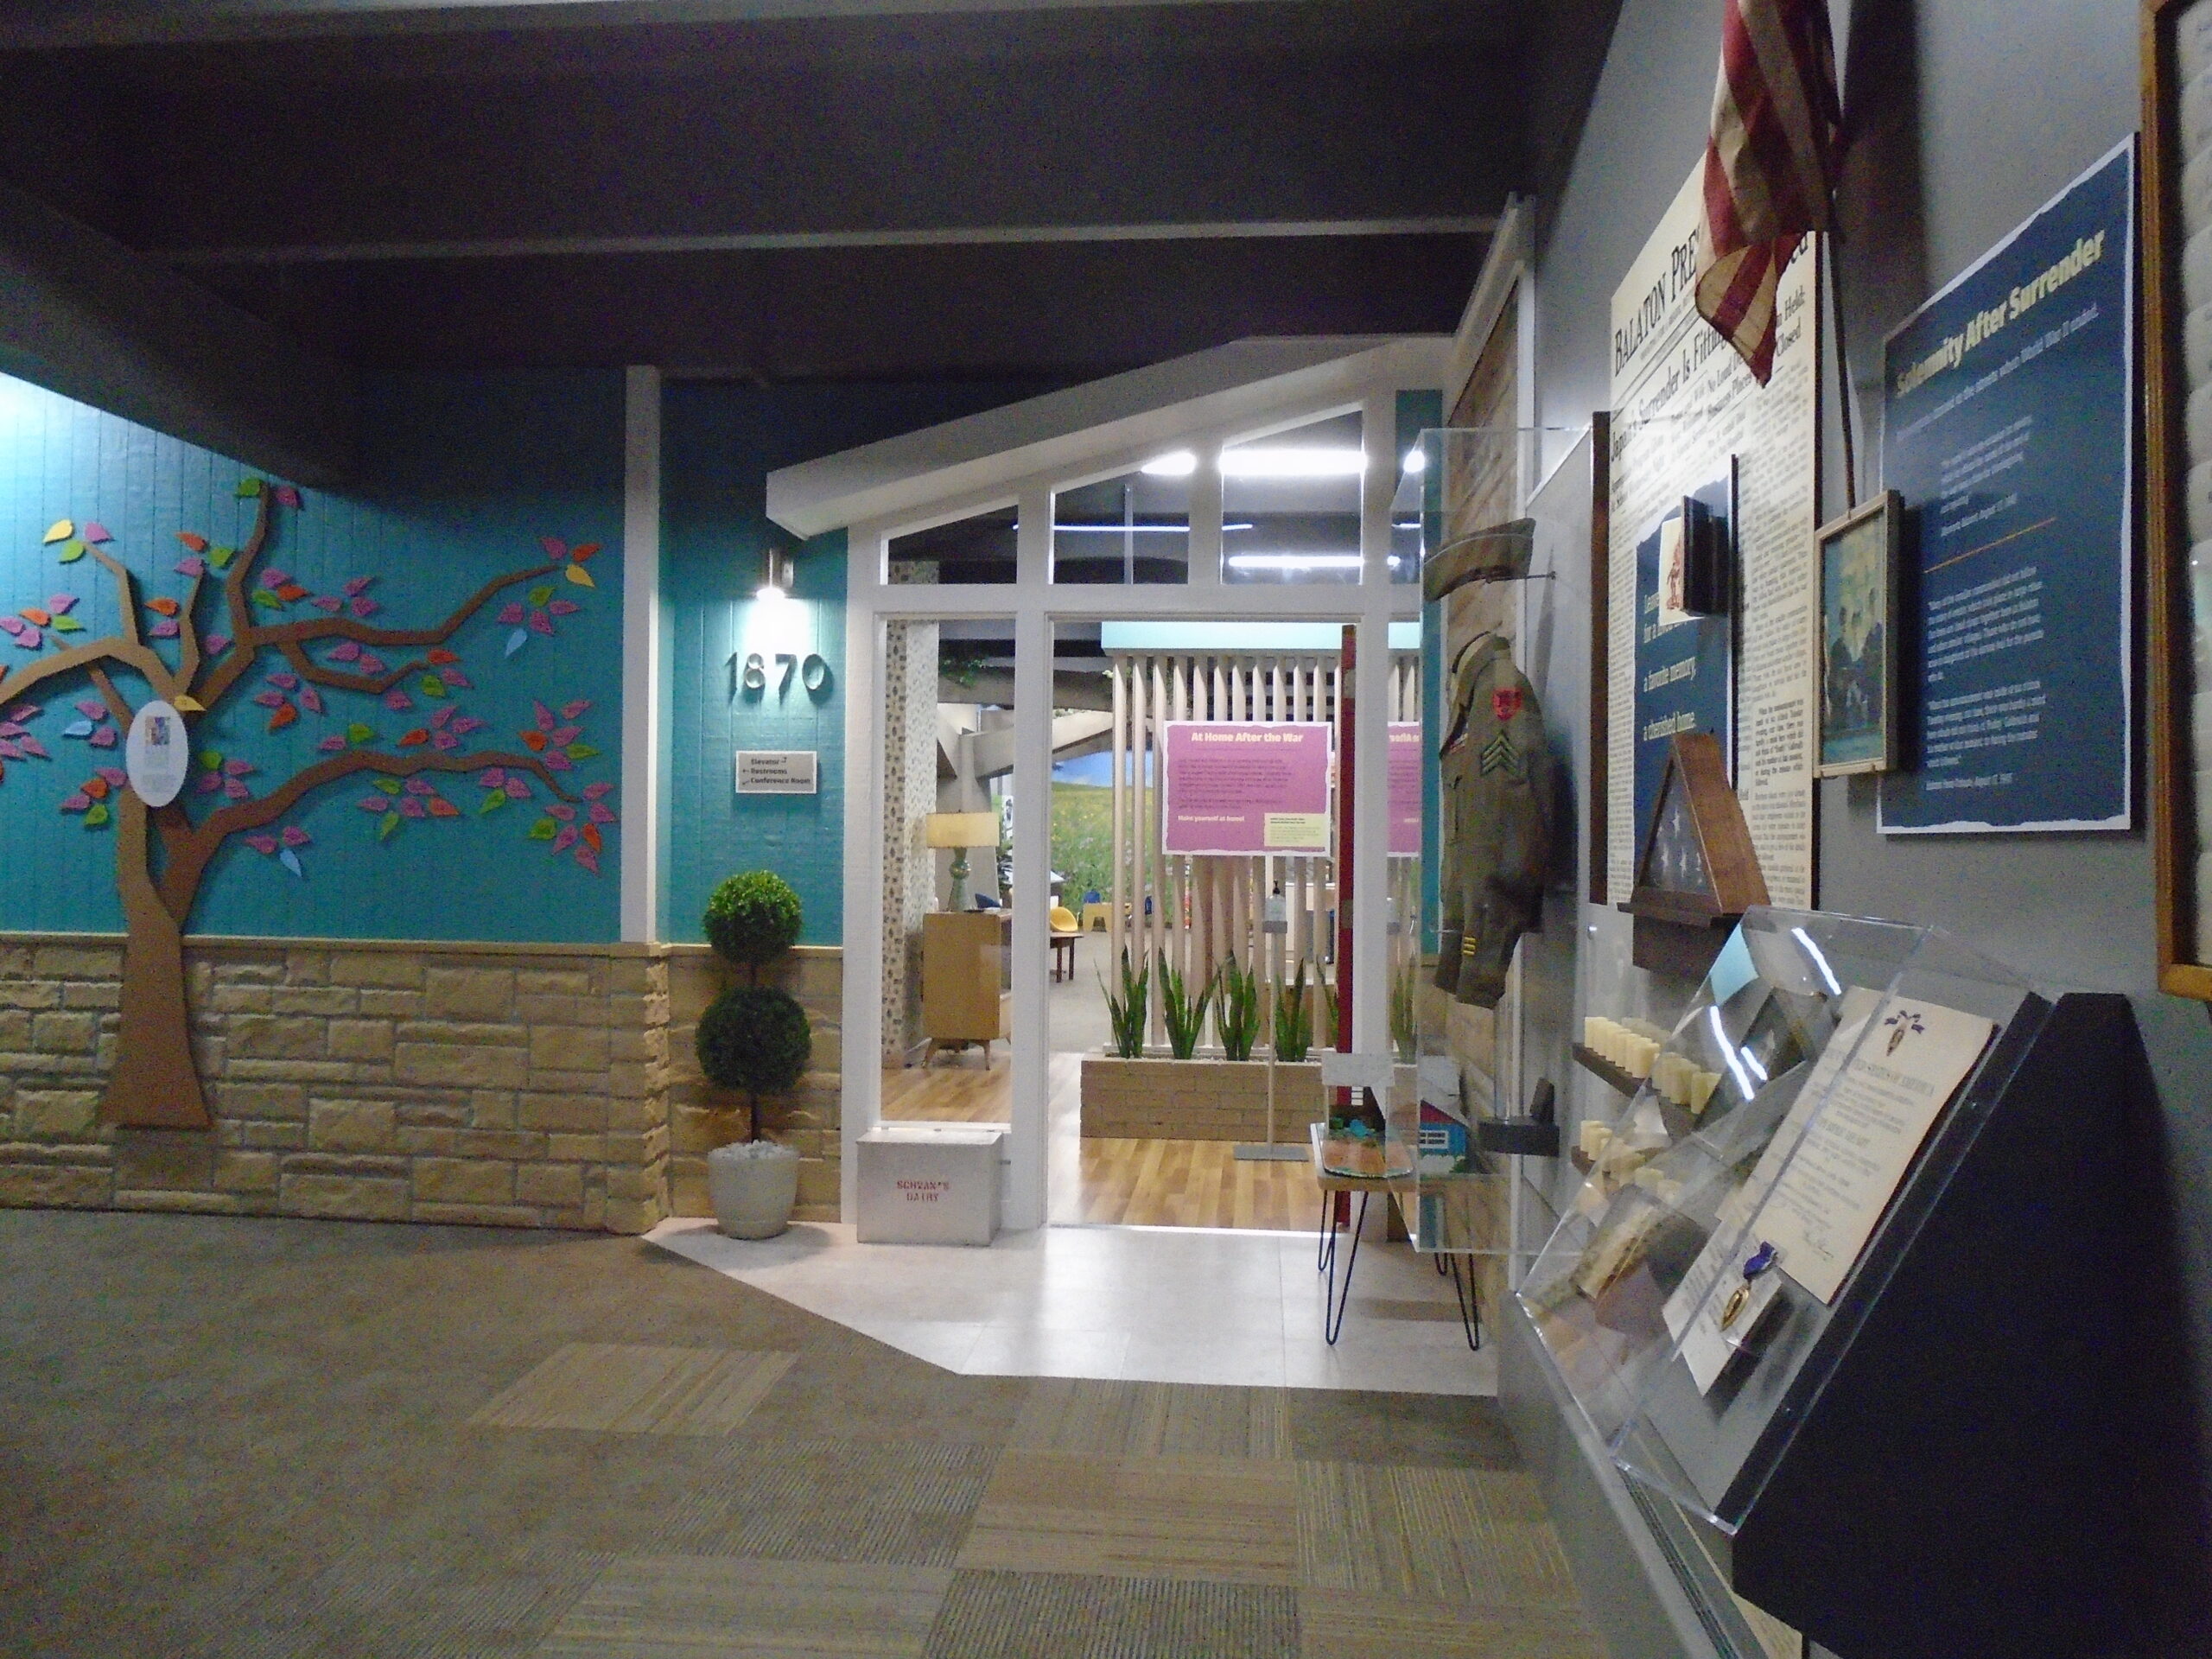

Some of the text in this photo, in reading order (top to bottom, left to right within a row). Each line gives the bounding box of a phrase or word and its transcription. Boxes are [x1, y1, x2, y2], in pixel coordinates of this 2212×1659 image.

[1966, 301, 2007, 352] After
[2009, 230, 2105, 320] Surrender
[1615, 271, 1666, 377] BALATON
[1639, 365, 1680, 419] Surrender
[725, 652, 831, 700] 1870
[1192, 732, 1304, 742] At Home After the War
[907, 1192, 939, 1202] DAIRY
